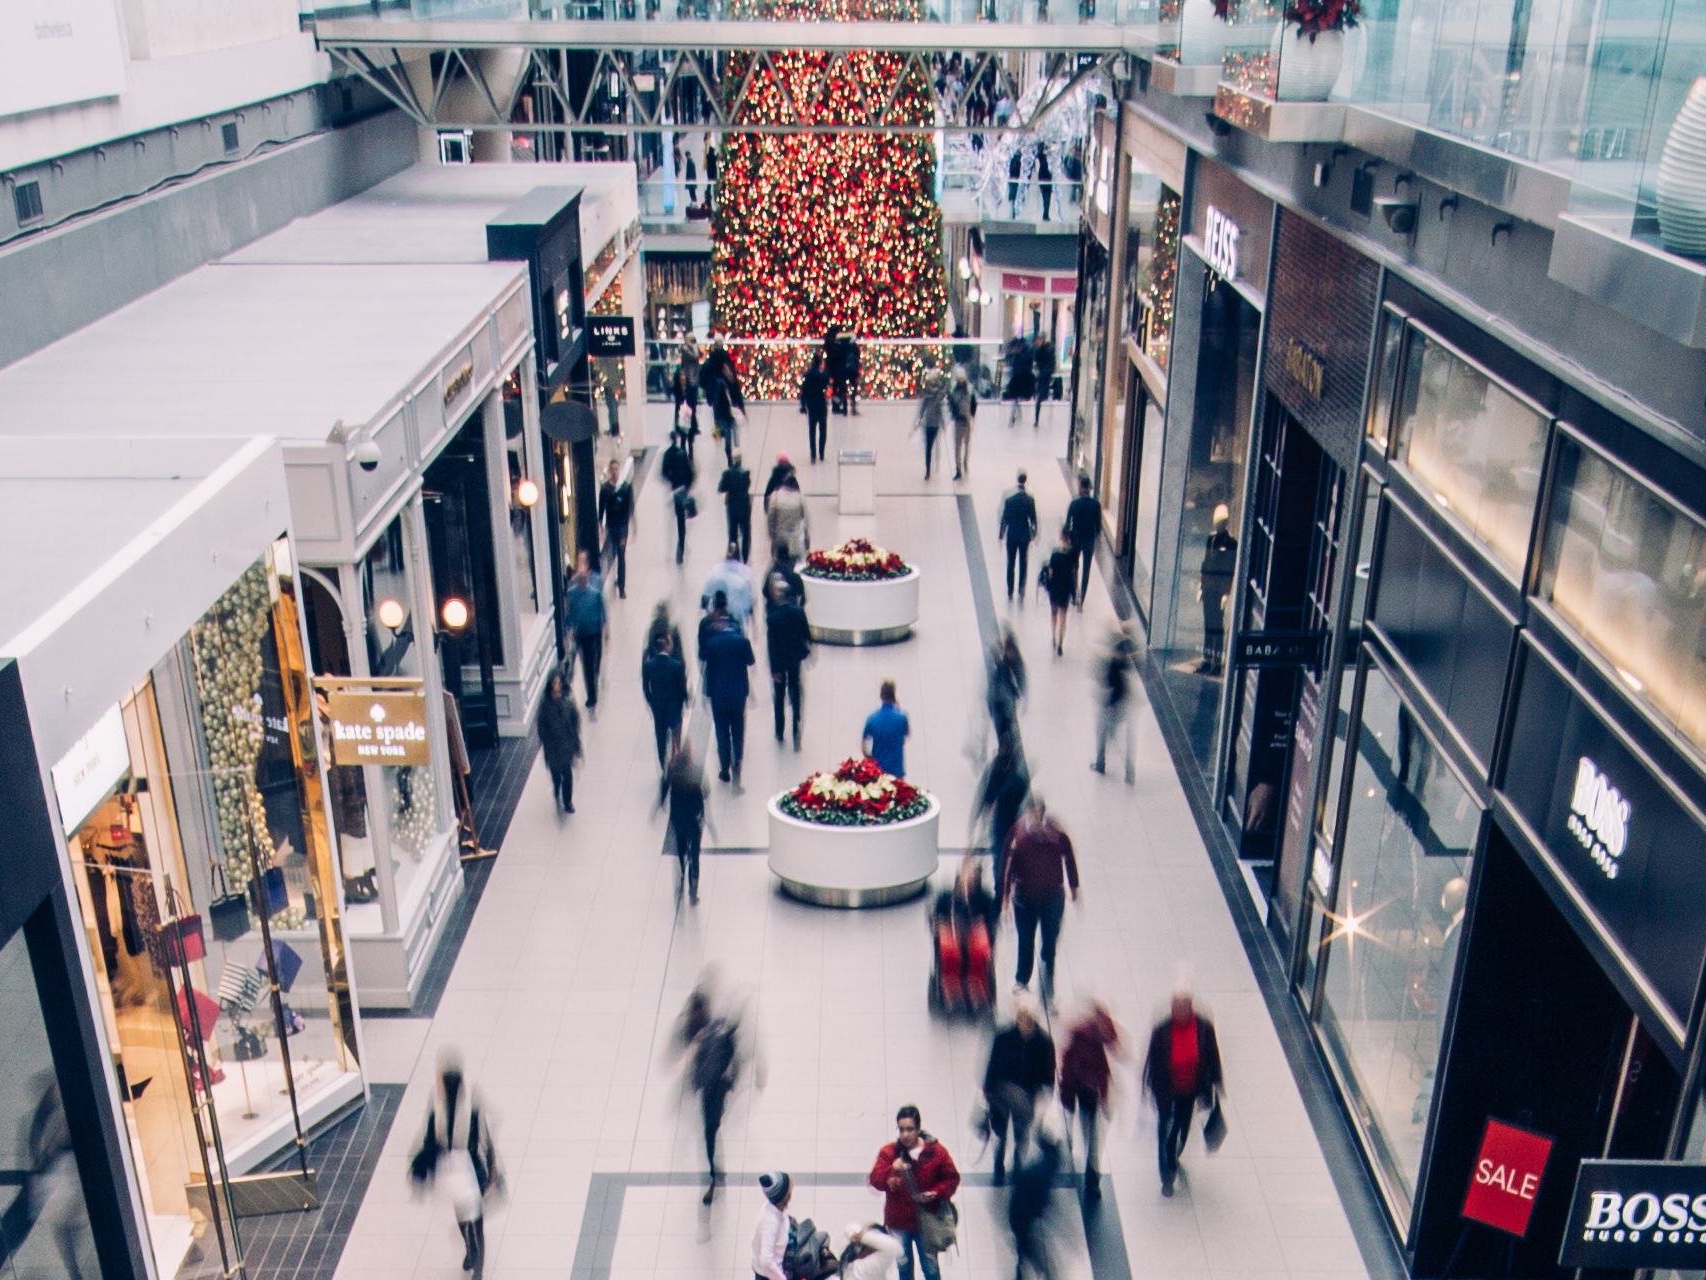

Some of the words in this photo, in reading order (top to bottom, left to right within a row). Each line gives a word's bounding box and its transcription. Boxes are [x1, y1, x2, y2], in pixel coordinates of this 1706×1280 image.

[1204, 204, 1240, 282] REISS
[593, 326, 628, 336] LINKS
[333, 720, 372, 740] kate
[375, 721, 426, 745] spade
[357, 745, 378, 755] NEW
[380, 745, 406, 756] YORK
[1570, 756, 1631, 857] BOSS
[1475, 1158, 1539, 1201] SALE
[1582, 1230, 1641, 1243] HUGO
